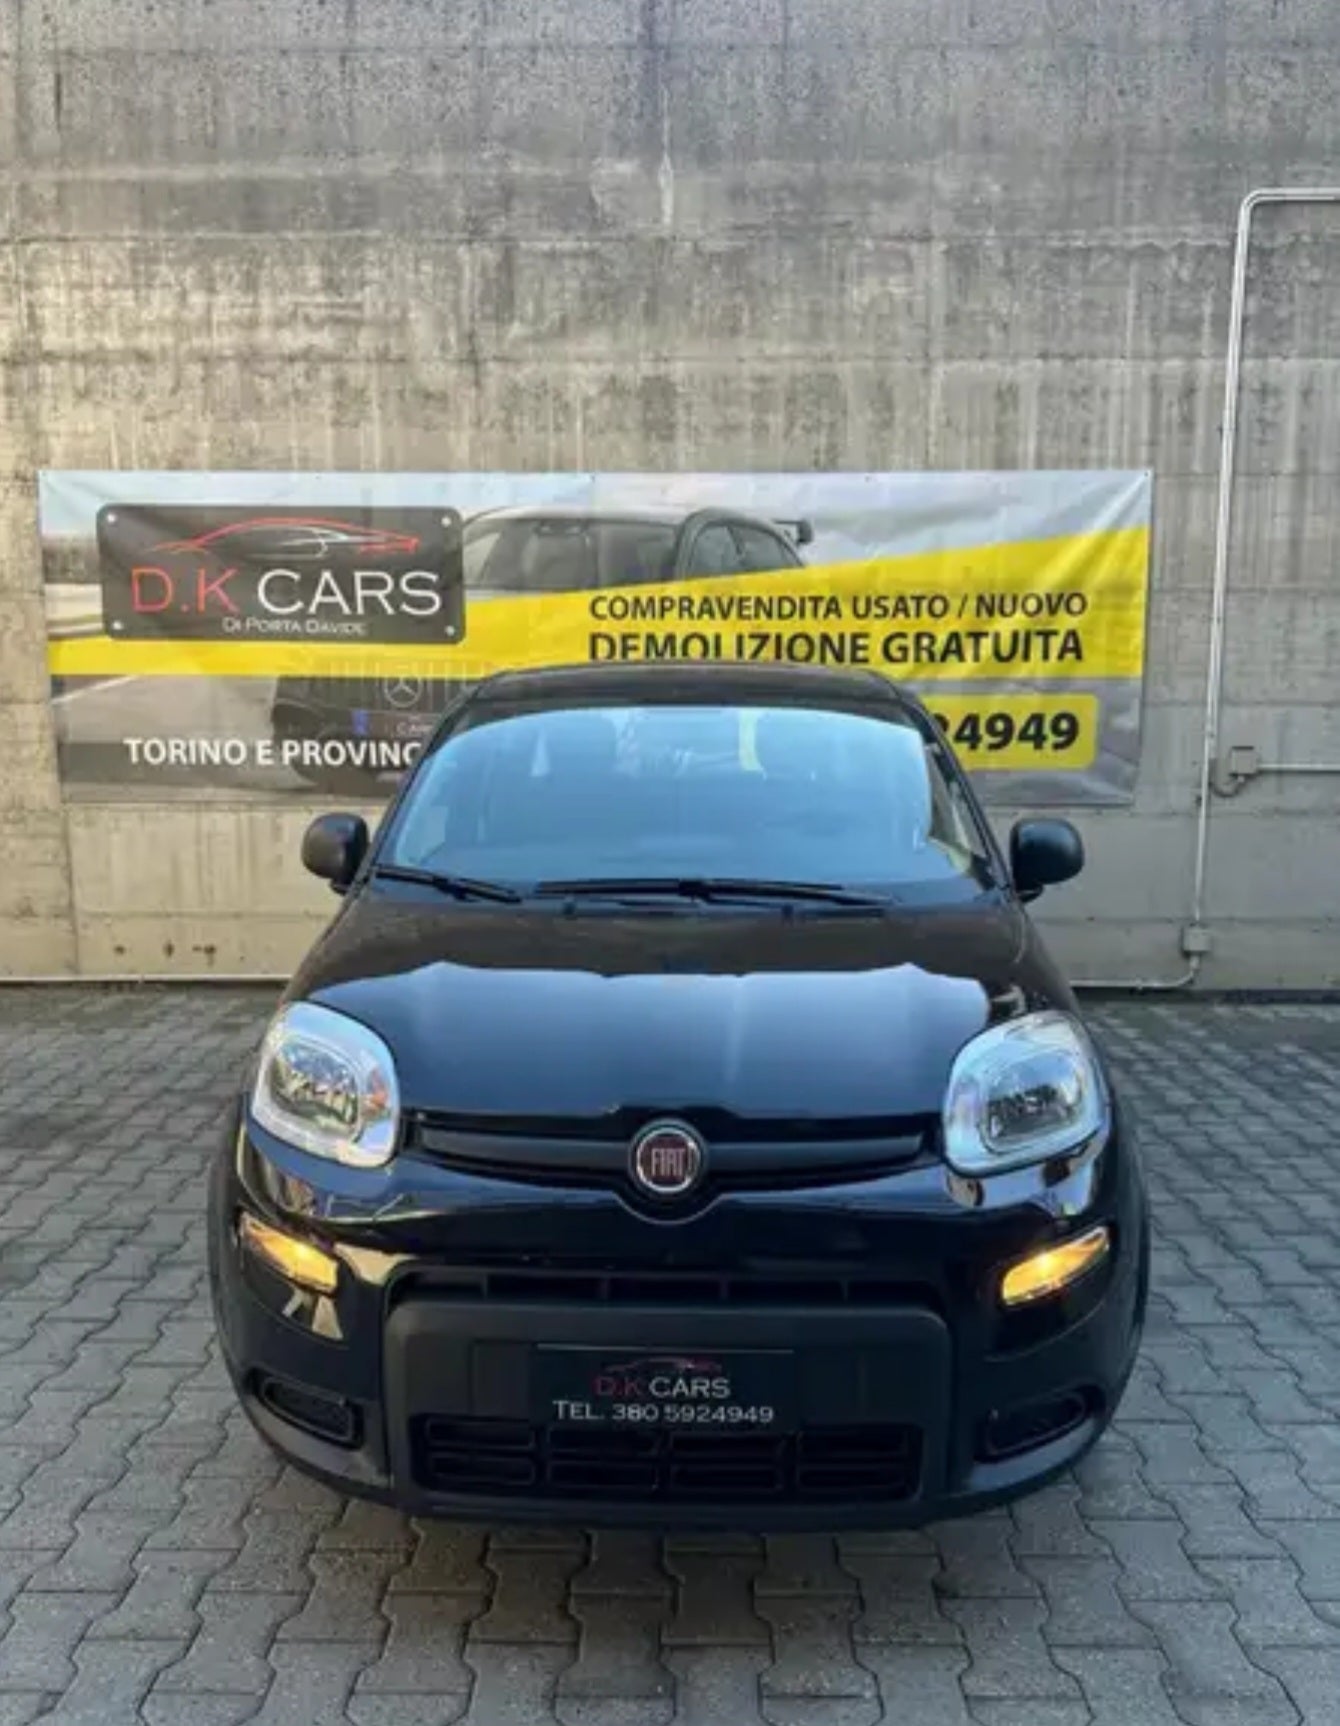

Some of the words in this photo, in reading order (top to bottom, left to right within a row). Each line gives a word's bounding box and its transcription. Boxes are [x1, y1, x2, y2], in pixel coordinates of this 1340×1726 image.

[131, 567, 240, 613] D.K
[257, 568, 442, 615] CARS
[589, 594, 842, 620] COMPRAVENDITA
[852, 595, 949, 619] USATO
[957, 594, 968, 619] /
[974, 592, 1088, 618] NUOVO
[881, 629, 1083, 663] GRATUITA
[124, 737, 247, 765] TORINO
[255, 740, 274, 766] E
[651, 1148, 685, 1176] FIAT
[595, 1377, 641, 1396] D.K
[648, 1377, 731, 1399] CARS
[552, 1400, 604, 1421] TEL.
[612, 1403, 659, 1421] 380
[664, 1405, 774, 1422] 5924949
